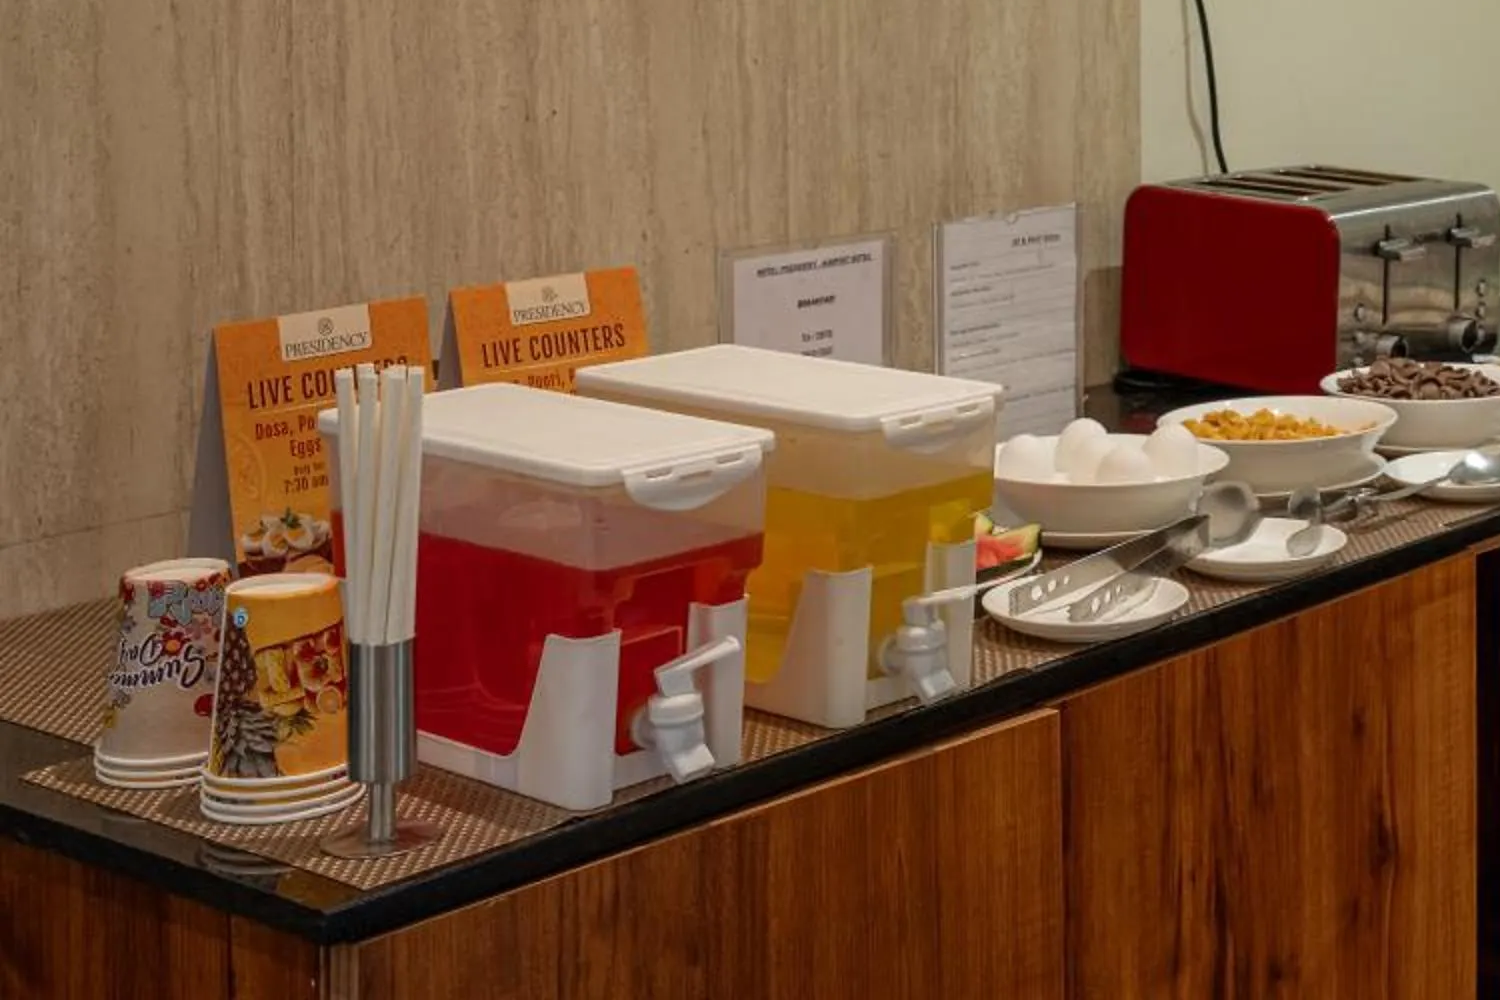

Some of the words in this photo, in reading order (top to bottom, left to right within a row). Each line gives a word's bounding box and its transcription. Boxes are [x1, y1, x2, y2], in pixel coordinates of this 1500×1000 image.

[514, 301, 585, 322] PRESIDENCY
[286, 332, 368, 358] PRESIDENCY
[481, 338, 522, 368] LIVE
[529, 323, 626, 361] COUNTERS
[247, 375, 294, 409] LIVE
[255, 421, 293, 440] Dosa,
[290, 438, 322, 459] Eggs
